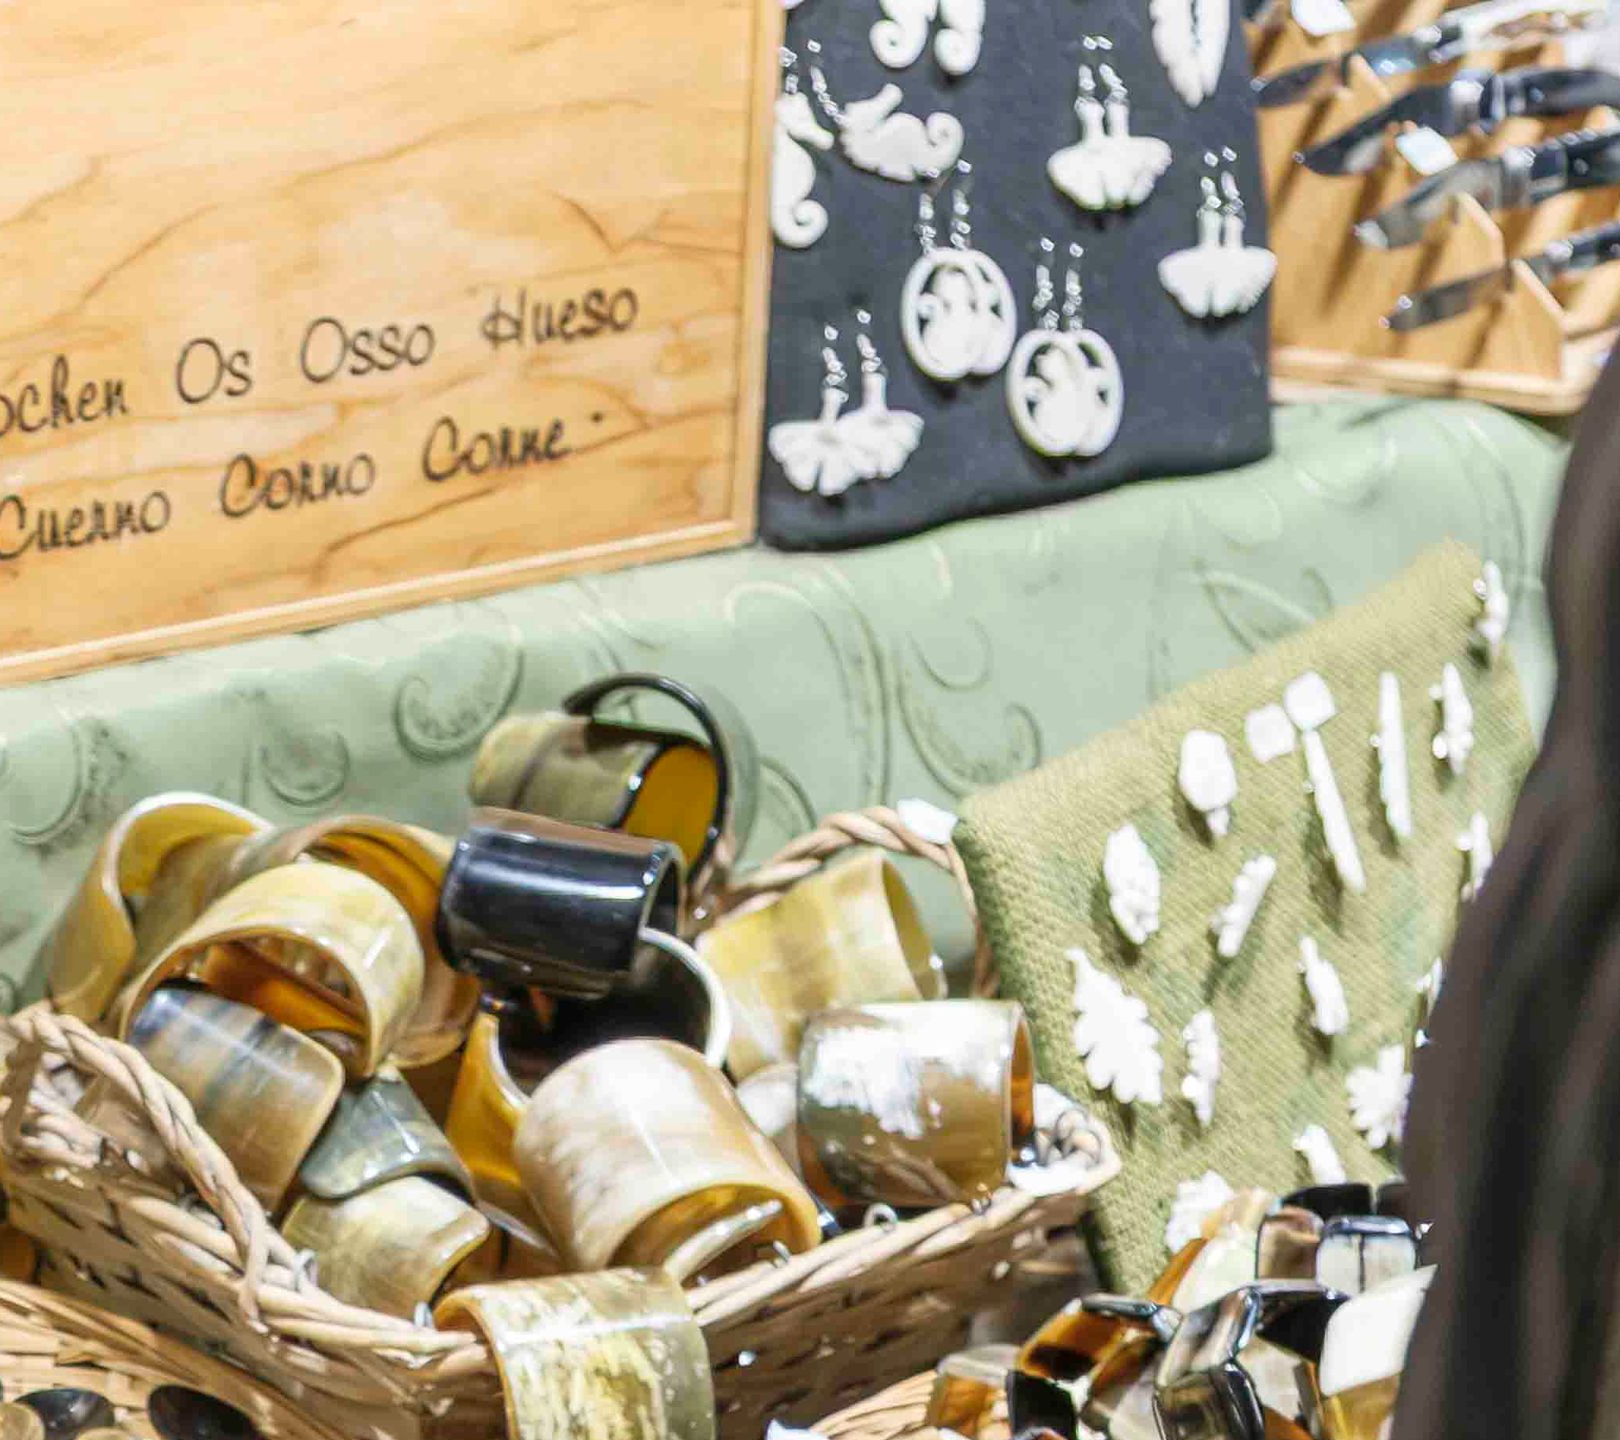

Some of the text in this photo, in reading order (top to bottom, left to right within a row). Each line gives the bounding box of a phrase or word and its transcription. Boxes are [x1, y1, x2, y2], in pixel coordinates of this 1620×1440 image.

[176, 337, 253, 403] Os
[300, 317, 436, 383] Osso
[479, 287, 638, 350] Hueso
[219, 453, 376, 518] Corno
[422, 416, 572, 482] Corne
